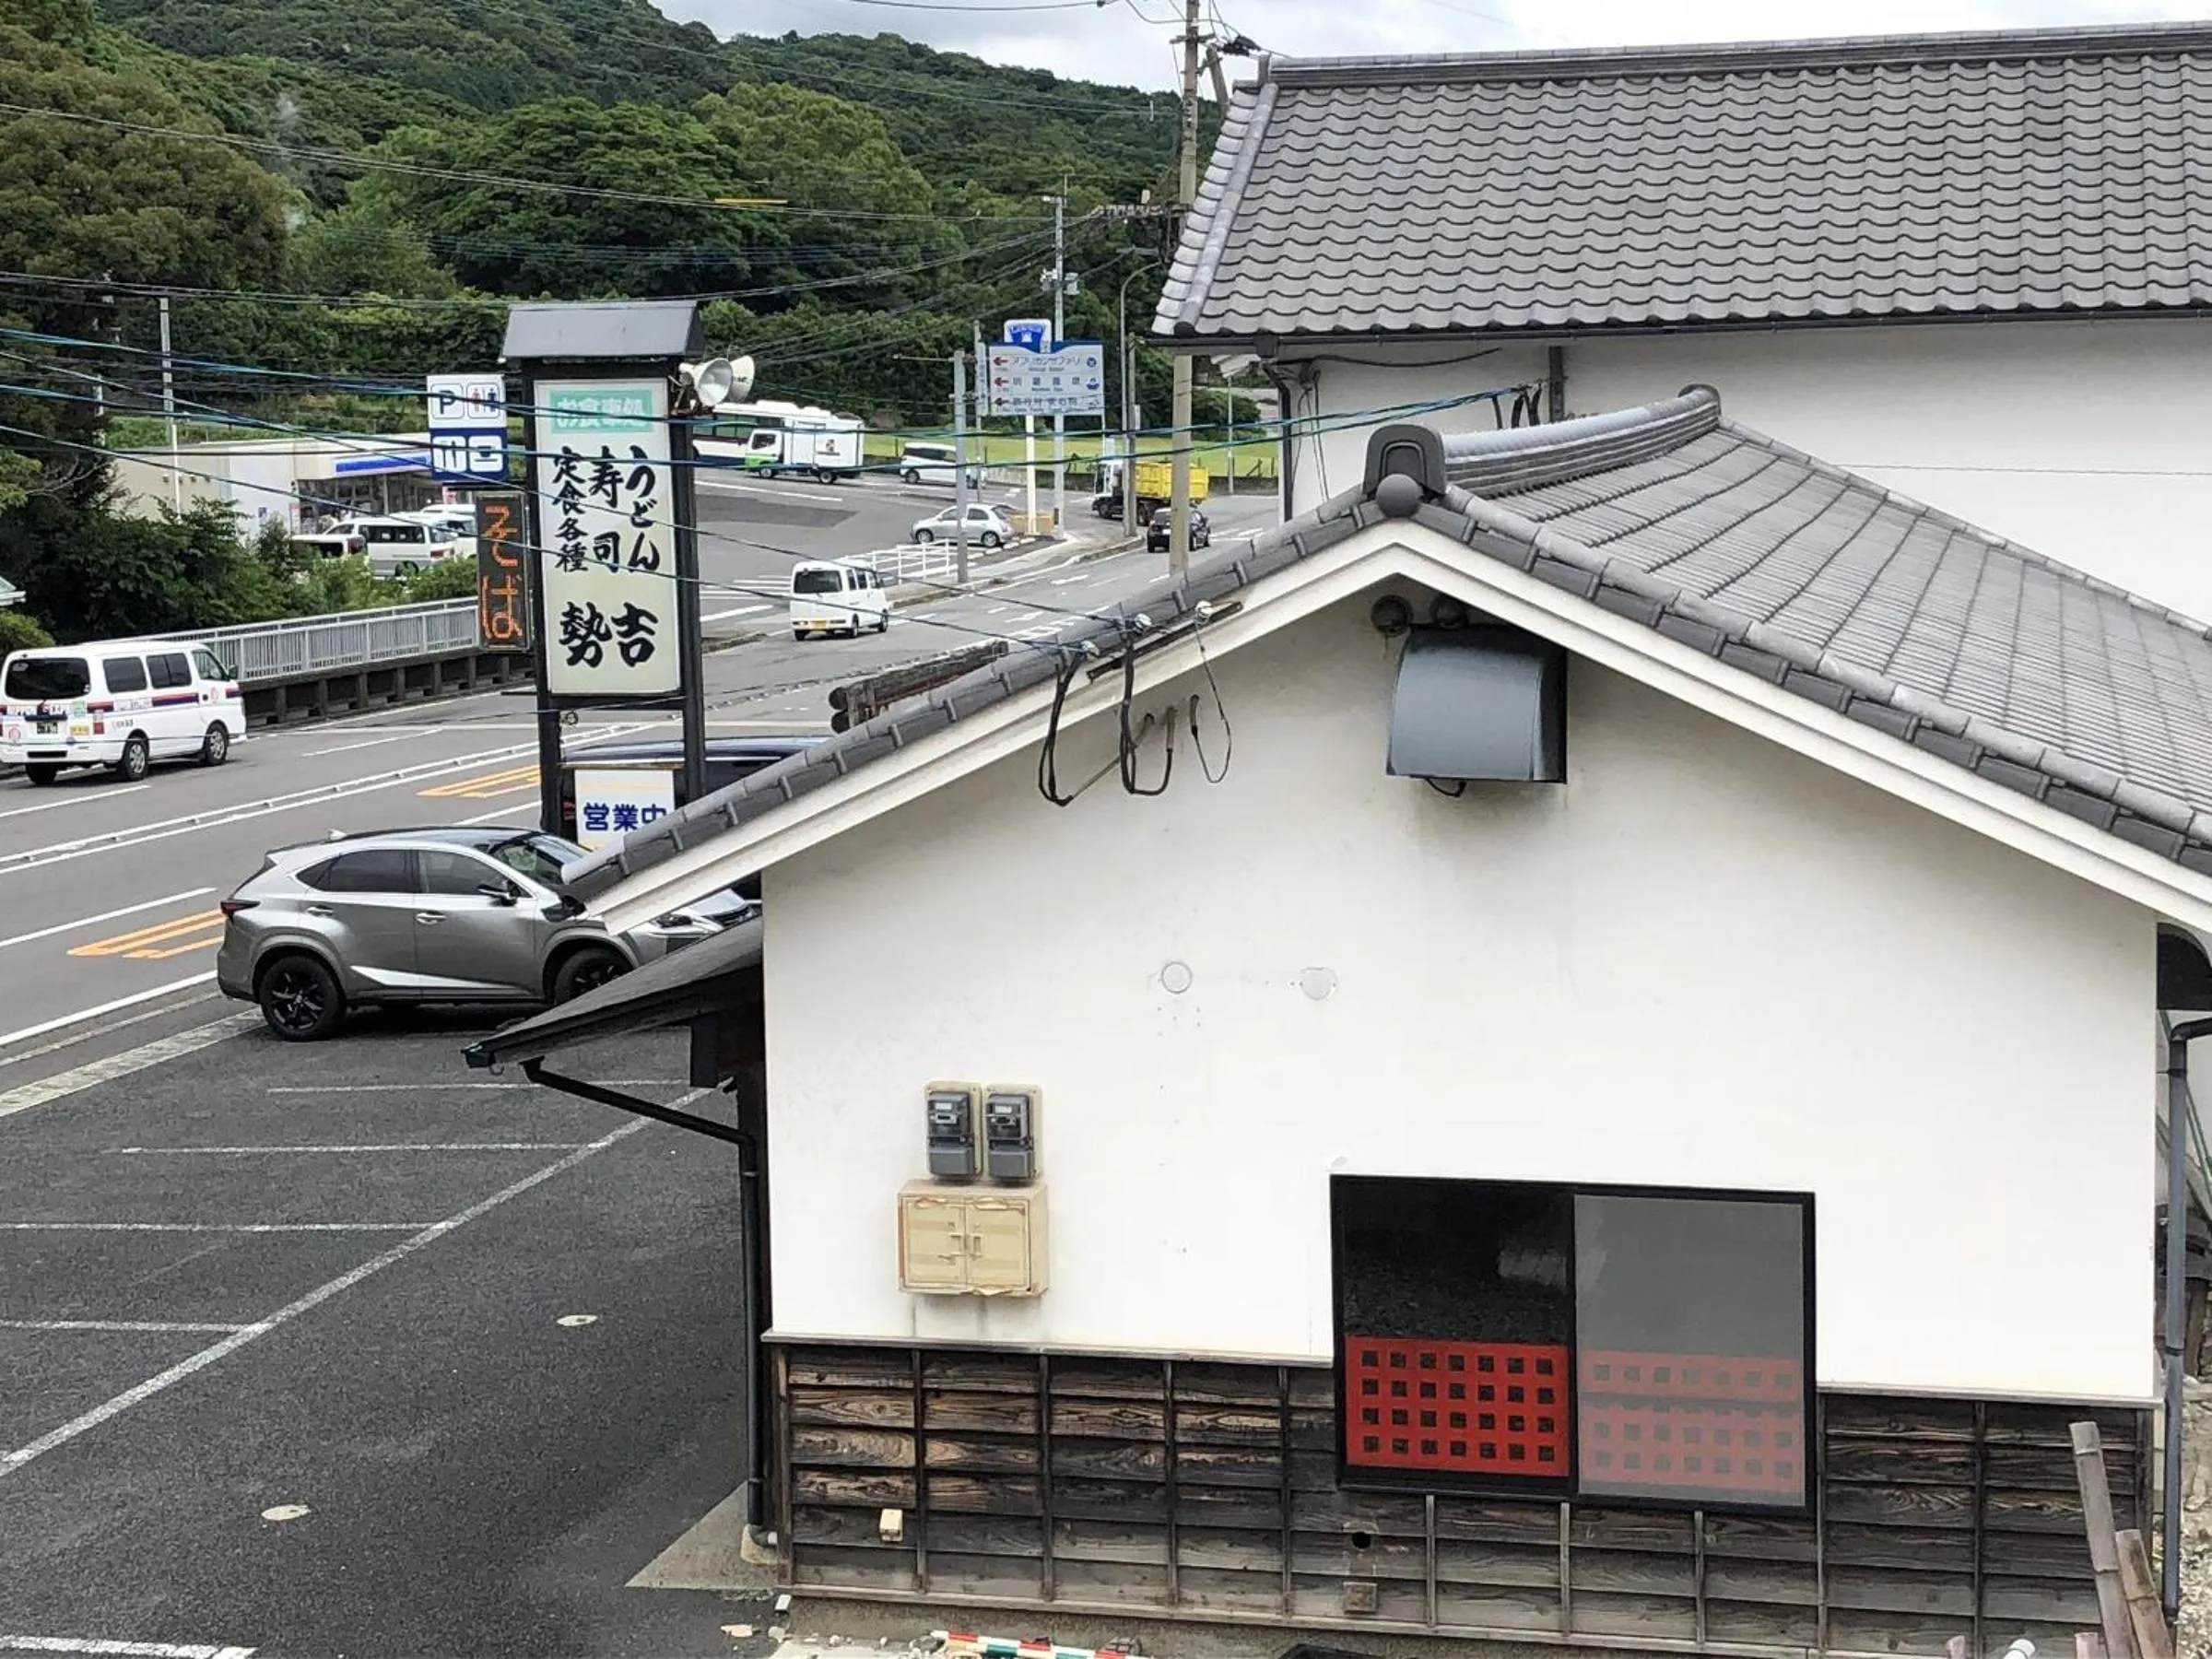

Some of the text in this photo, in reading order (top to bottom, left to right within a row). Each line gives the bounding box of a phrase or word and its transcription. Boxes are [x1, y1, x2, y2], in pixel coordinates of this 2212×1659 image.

[440, 390, 454, 415] P
[551, 445, 589, 573] 定食各種
[587, 445, 625, 573] 寿司
[625, 444, 661, 572] うどん
[481, 505, 524, 640] そば
